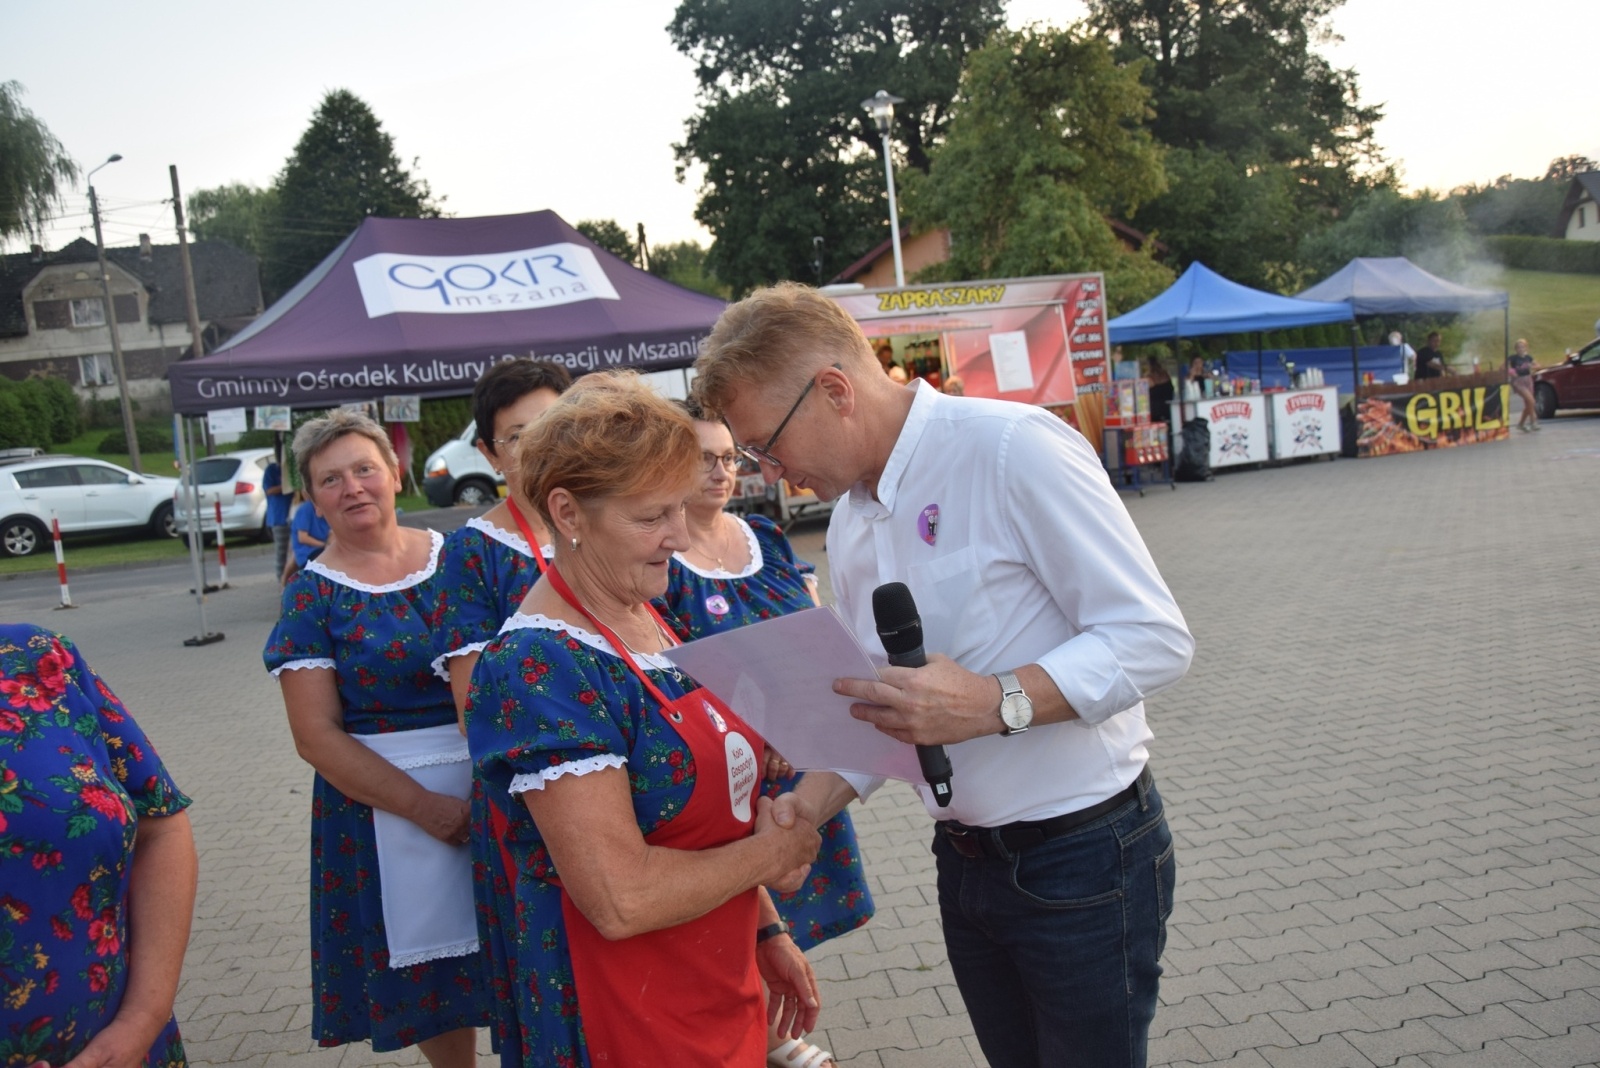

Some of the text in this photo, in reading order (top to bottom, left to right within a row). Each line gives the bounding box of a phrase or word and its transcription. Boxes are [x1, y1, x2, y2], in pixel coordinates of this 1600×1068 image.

[455, 281, 589, 307] mszana
[877, 284, 1006, 312] ZAPRASZAMY
[198, 375, 290, 398] Gminny
[297, 363, 398, 391] Ośrodek
[402, 359, 485, 383] Kultury
[502, 345, 600, 371] Rkreacji
[603, 348, 622, 364] w
[627, 336, 706, 362] Mszani
